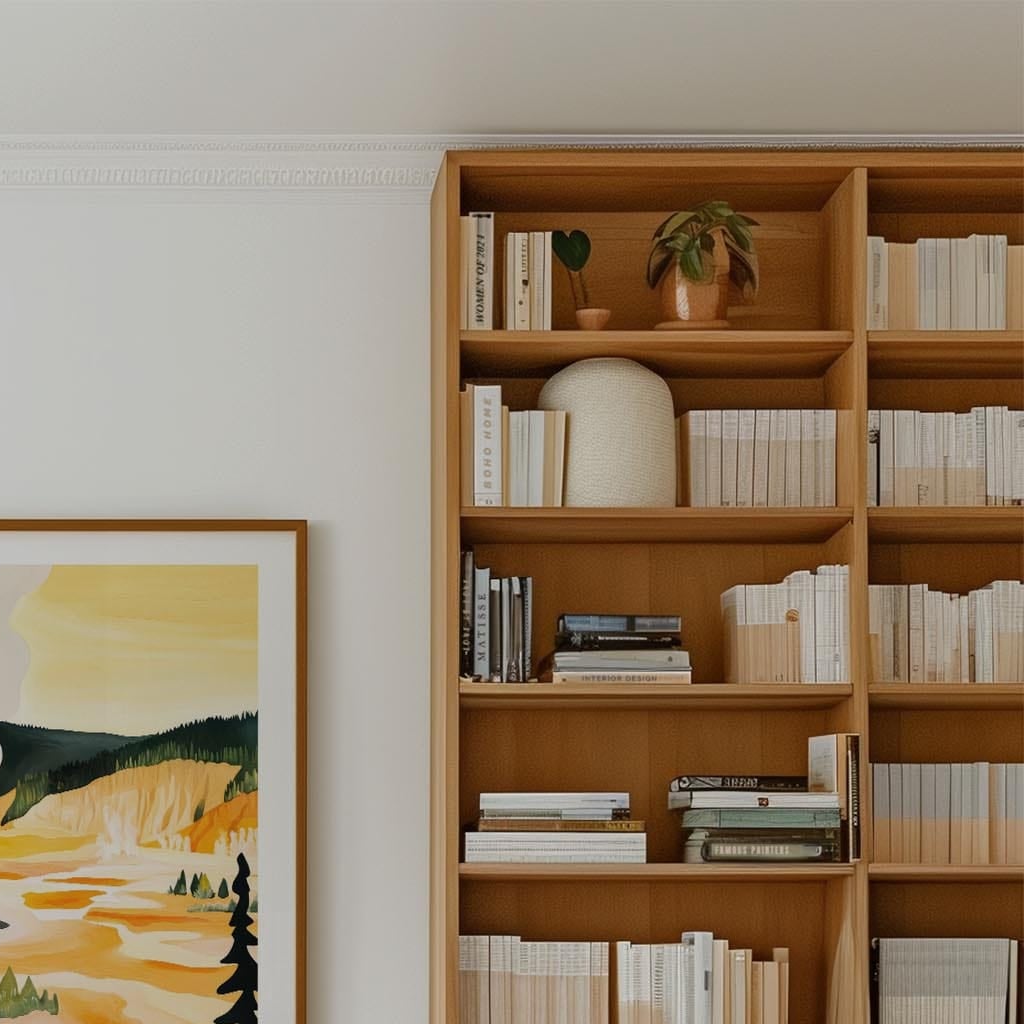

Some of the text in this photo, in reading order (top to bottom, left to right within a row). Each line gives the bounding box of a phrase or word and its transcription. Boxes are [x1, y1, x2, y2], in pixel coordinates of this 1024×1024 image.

[476, 259, 485, 276] OF
[476, 279, 485, 323] WOMEN
[483, 397, 492, 489] BOHO HOME
[477, 593, 486, 661] MATISSE
[582, 674, 657, 682] INTERIOR DESIGN
[714, 846, 790, 855] FAMOUS PAINTERS
